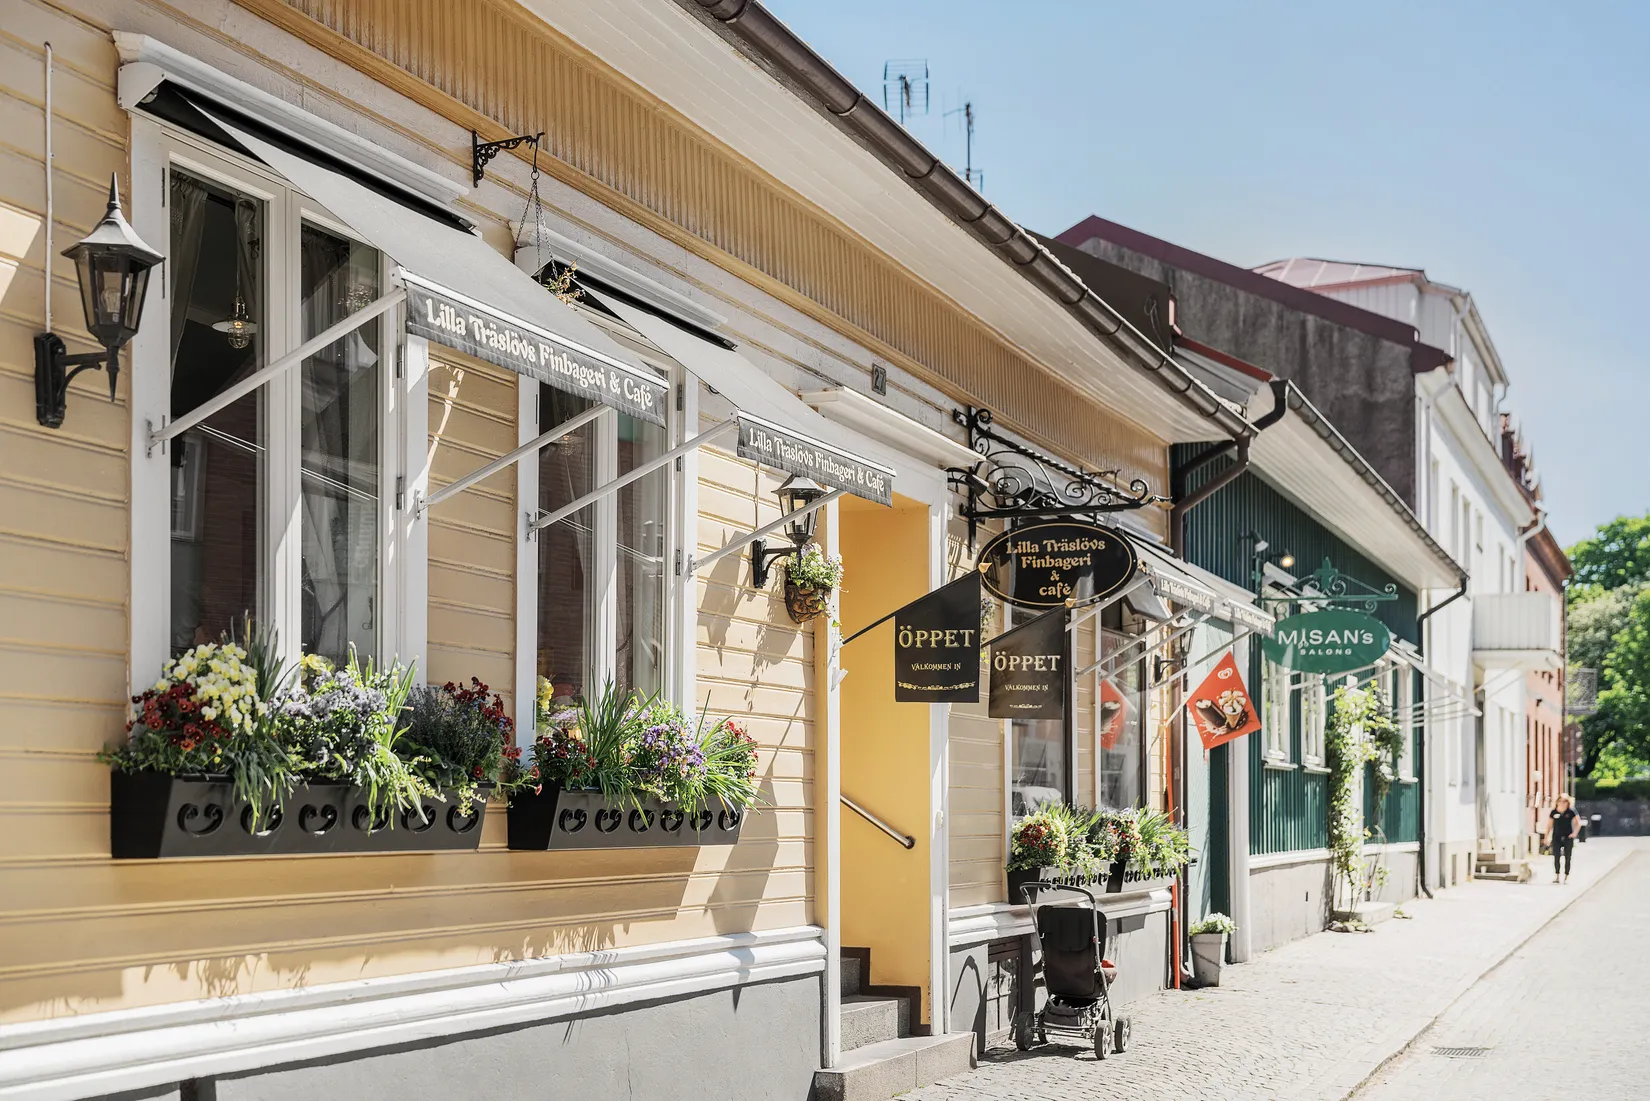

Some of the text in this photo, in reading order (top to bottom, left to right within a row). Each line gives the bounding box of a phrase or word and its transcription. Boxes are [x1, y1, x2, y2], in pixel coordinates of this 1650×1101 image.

[426, 298, 653, 411] Lilla Träslövs Finbageri & Café
[749, 427, 885, 495] Lilla Träslövs Finbageri & Café
[1006, 537, 1106, 555] Lilla Träslövs
[1020, 552, 1092, 571] Finbageri
[1049, 569, 1061, 582] &
[1038, 581, 1072, 599] café
[898, 624, 976, 649] ÖPPET
[1299, 648, 1352, 656] SALONG
[953, 662, 962, 671] IN
[993, 650, 1062, 673] ÖPPET
[1041, 683, 1049, 692] IN
